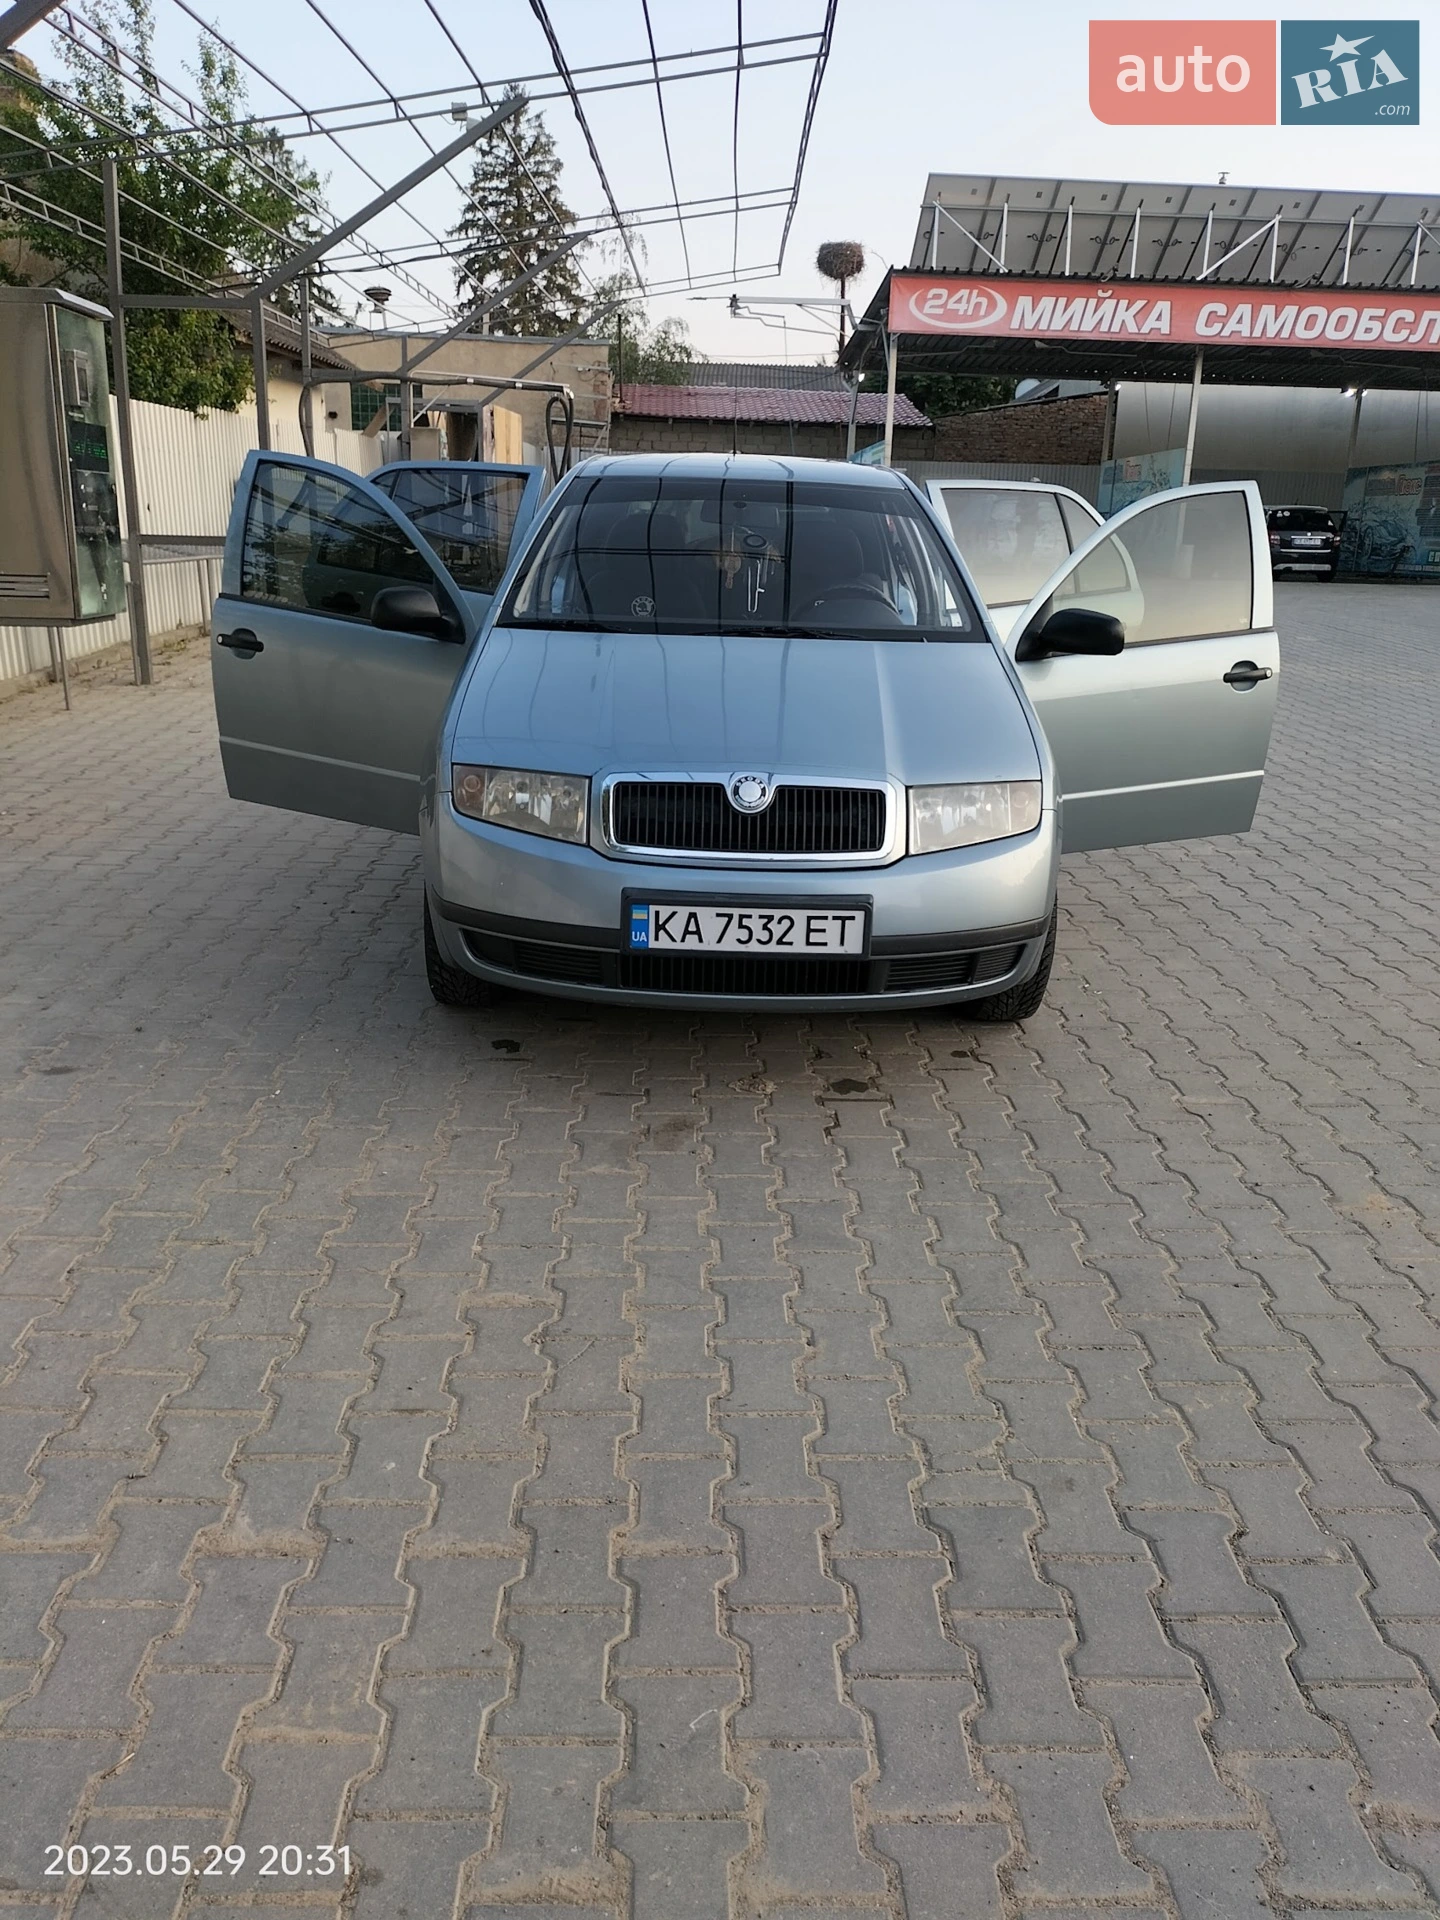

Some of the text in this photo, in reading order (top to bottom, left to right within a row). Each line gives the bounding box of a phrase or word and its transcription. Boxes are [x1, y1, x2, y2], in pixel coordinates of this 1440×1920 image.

[923, 288, 989, 316] 24h
[1009, 289, 1440, 344] МИЙКА САМООБСЛ
[632, 931, 648, 942] UA
[653, 910, 856, 947] KA 7532 ET
